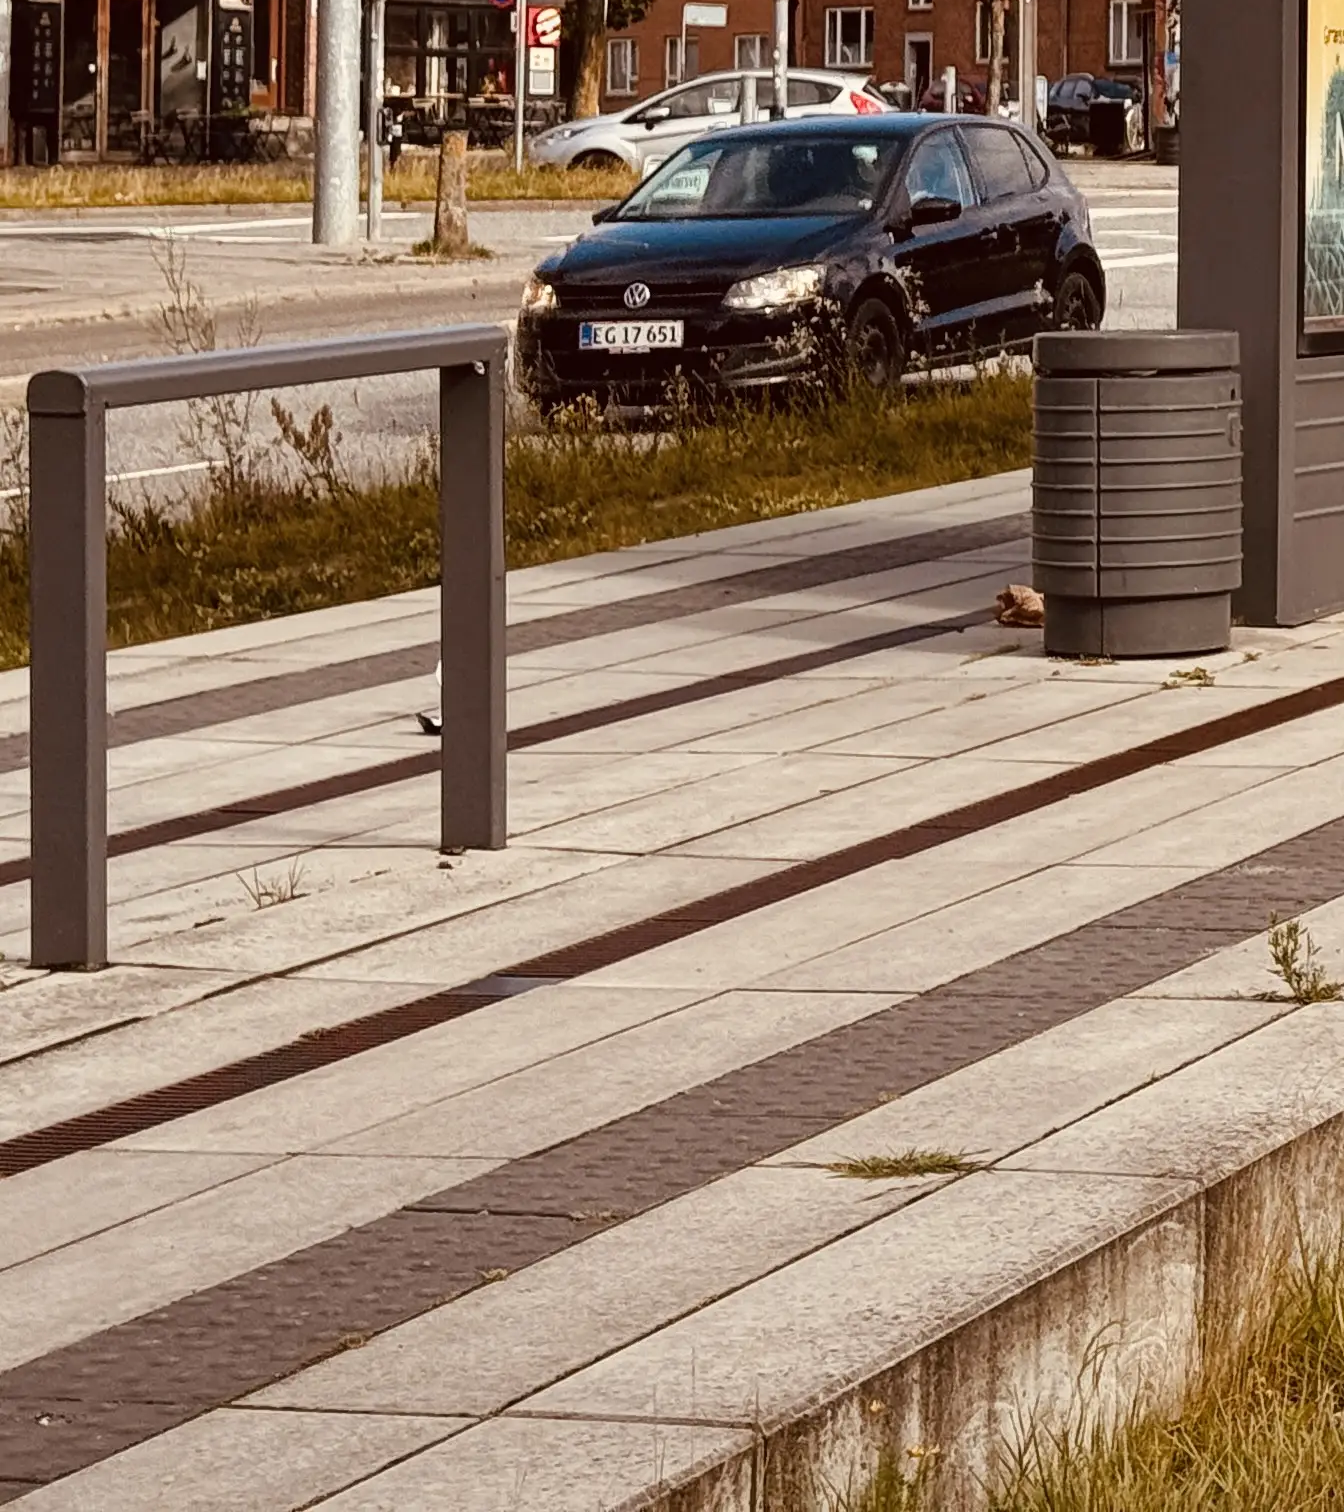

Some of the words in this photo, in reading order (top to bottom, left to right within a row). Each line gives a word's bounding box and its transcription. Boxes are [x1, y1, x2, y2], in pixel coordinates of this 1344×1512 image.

[593, 326, 617, 345] EG
[621, 326, 642, 345] 17
[646, 325, 678, 344] 651
